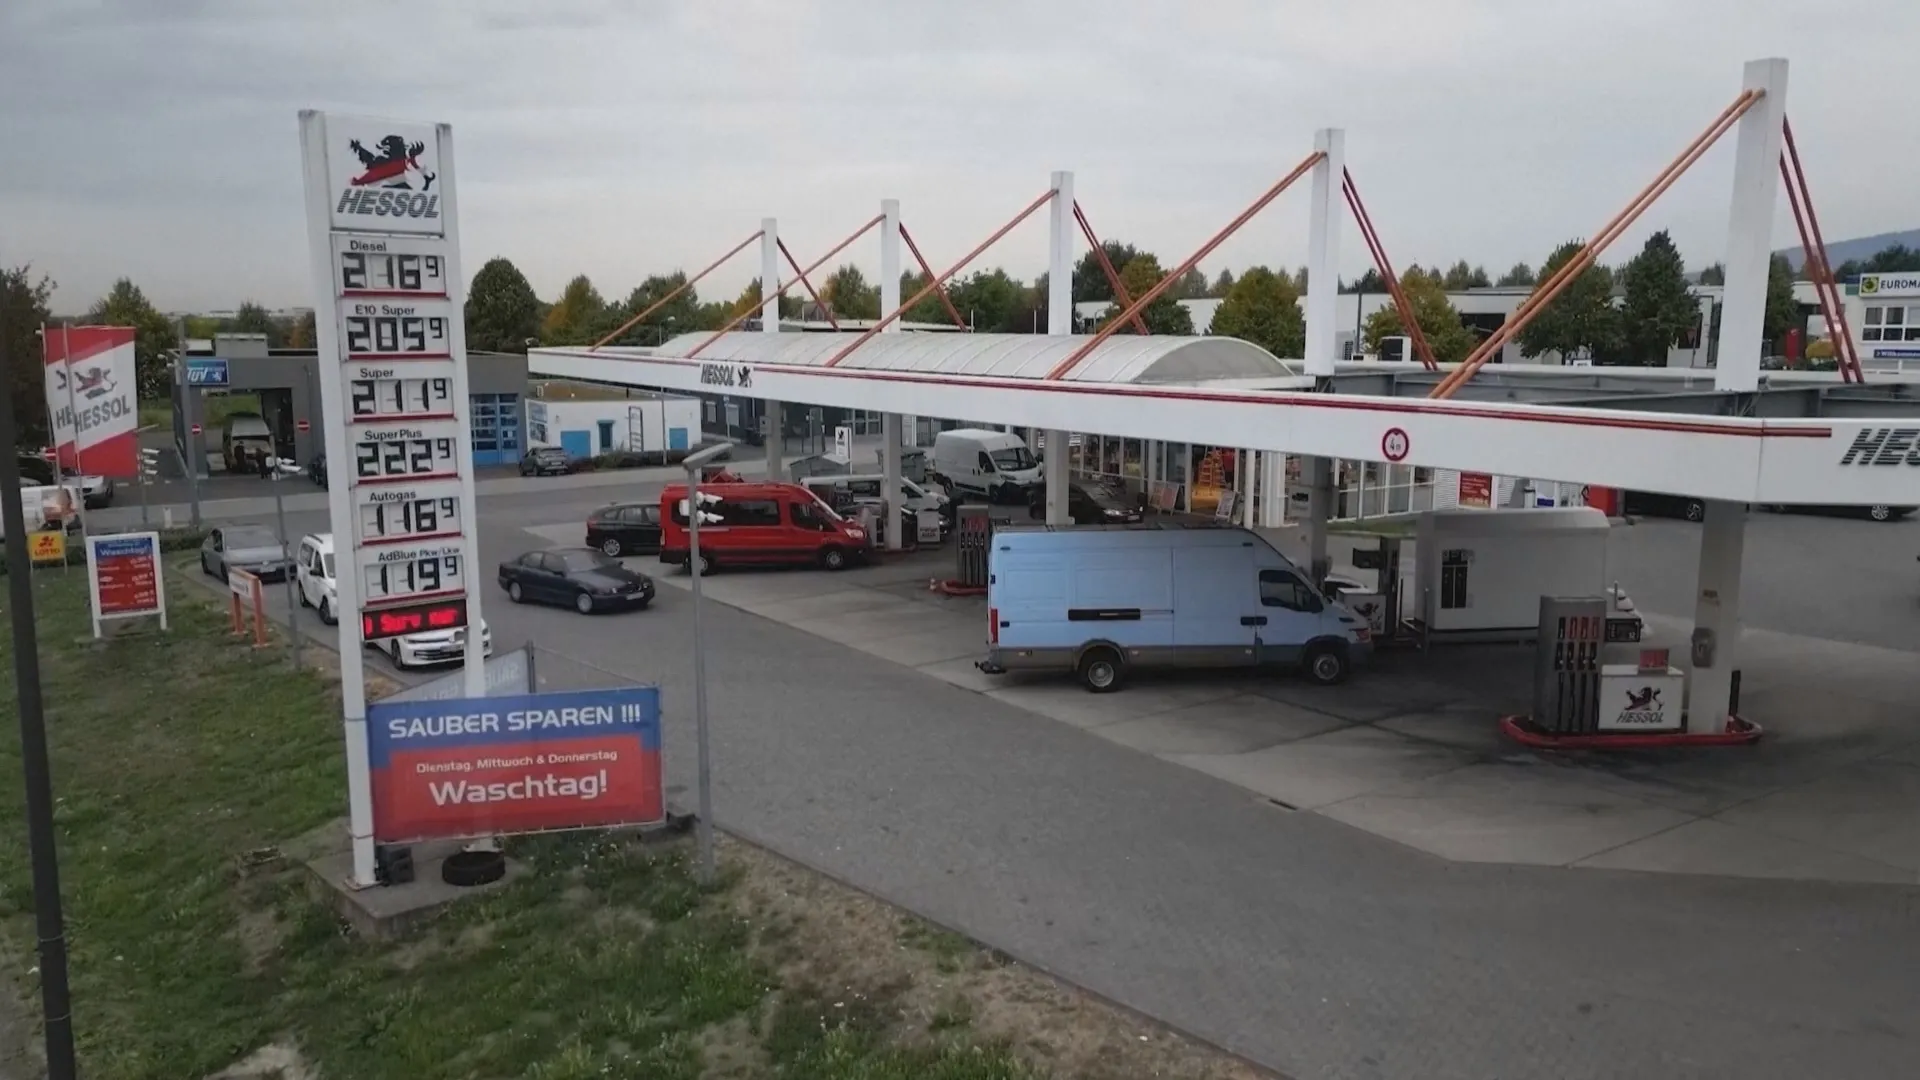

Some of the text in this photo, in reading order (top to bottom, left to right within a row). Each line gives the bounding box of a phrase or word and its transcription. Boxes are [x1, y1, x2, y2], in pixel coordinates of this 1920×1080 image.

[337, 189, 439, 218] HESSOL
[350, 240, 387, 252] Diesel
[355, 304, 415, 319] E10 Super
[360, 367, 394, 381] Super
[701, 363, 734, 386] HESSOL
[74, 395, 130, 432] HESSOL
[370, 489, 416, 502] Autogas
[378, 551, 416, 563] AdBlue
[389, 704, 641, 739] SAUBER SPAREN !!!
[1616, 711, 1664, 724] HESSOL
[416, 750, 618, 774] Dienstag, Mittwoch & Donnerstag
[428, 769, 607, 806] Waschtag!
